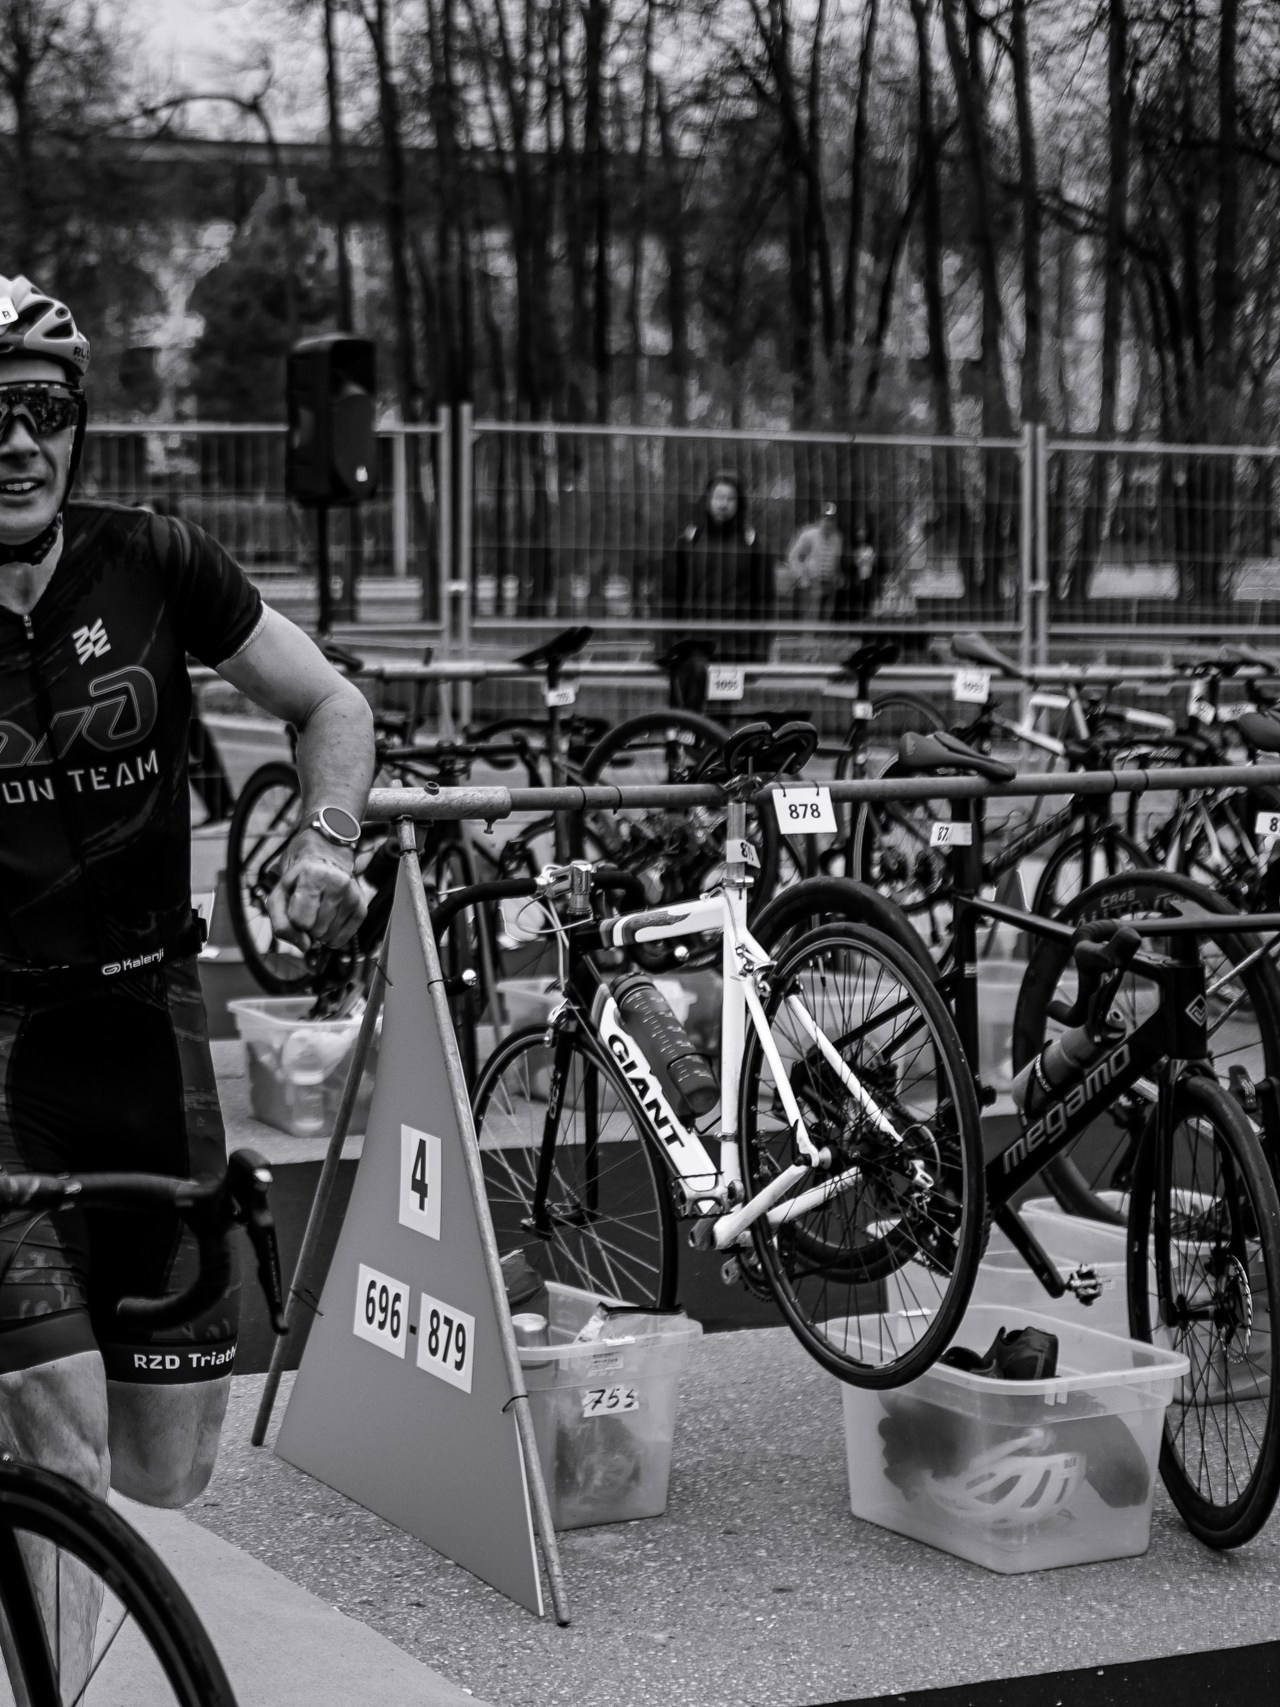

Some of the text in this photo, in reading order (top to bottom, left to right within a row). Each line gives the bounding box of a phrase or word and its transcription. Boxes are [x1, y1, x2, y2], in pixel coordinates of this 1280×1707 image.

[2, 310, 12, 321] B
[67, 748, 159, 792] TEAM
[788, 803, 821, 819] 878
[937, 826, 949, 841] 87
[1101, 890, 1136, 908] CR45
[123, 948, 164, 971] Kalenji
[608, 1034, 685, 1148] GIANT
[1004, 1044, 1131, 1174] megamo
[411, 1138, 428, 1212] 4
[365, 1280, 402, 1339] 696
[428, 1308, 466, 1371] 879
[133, 1353, 181, 1369] RZD
